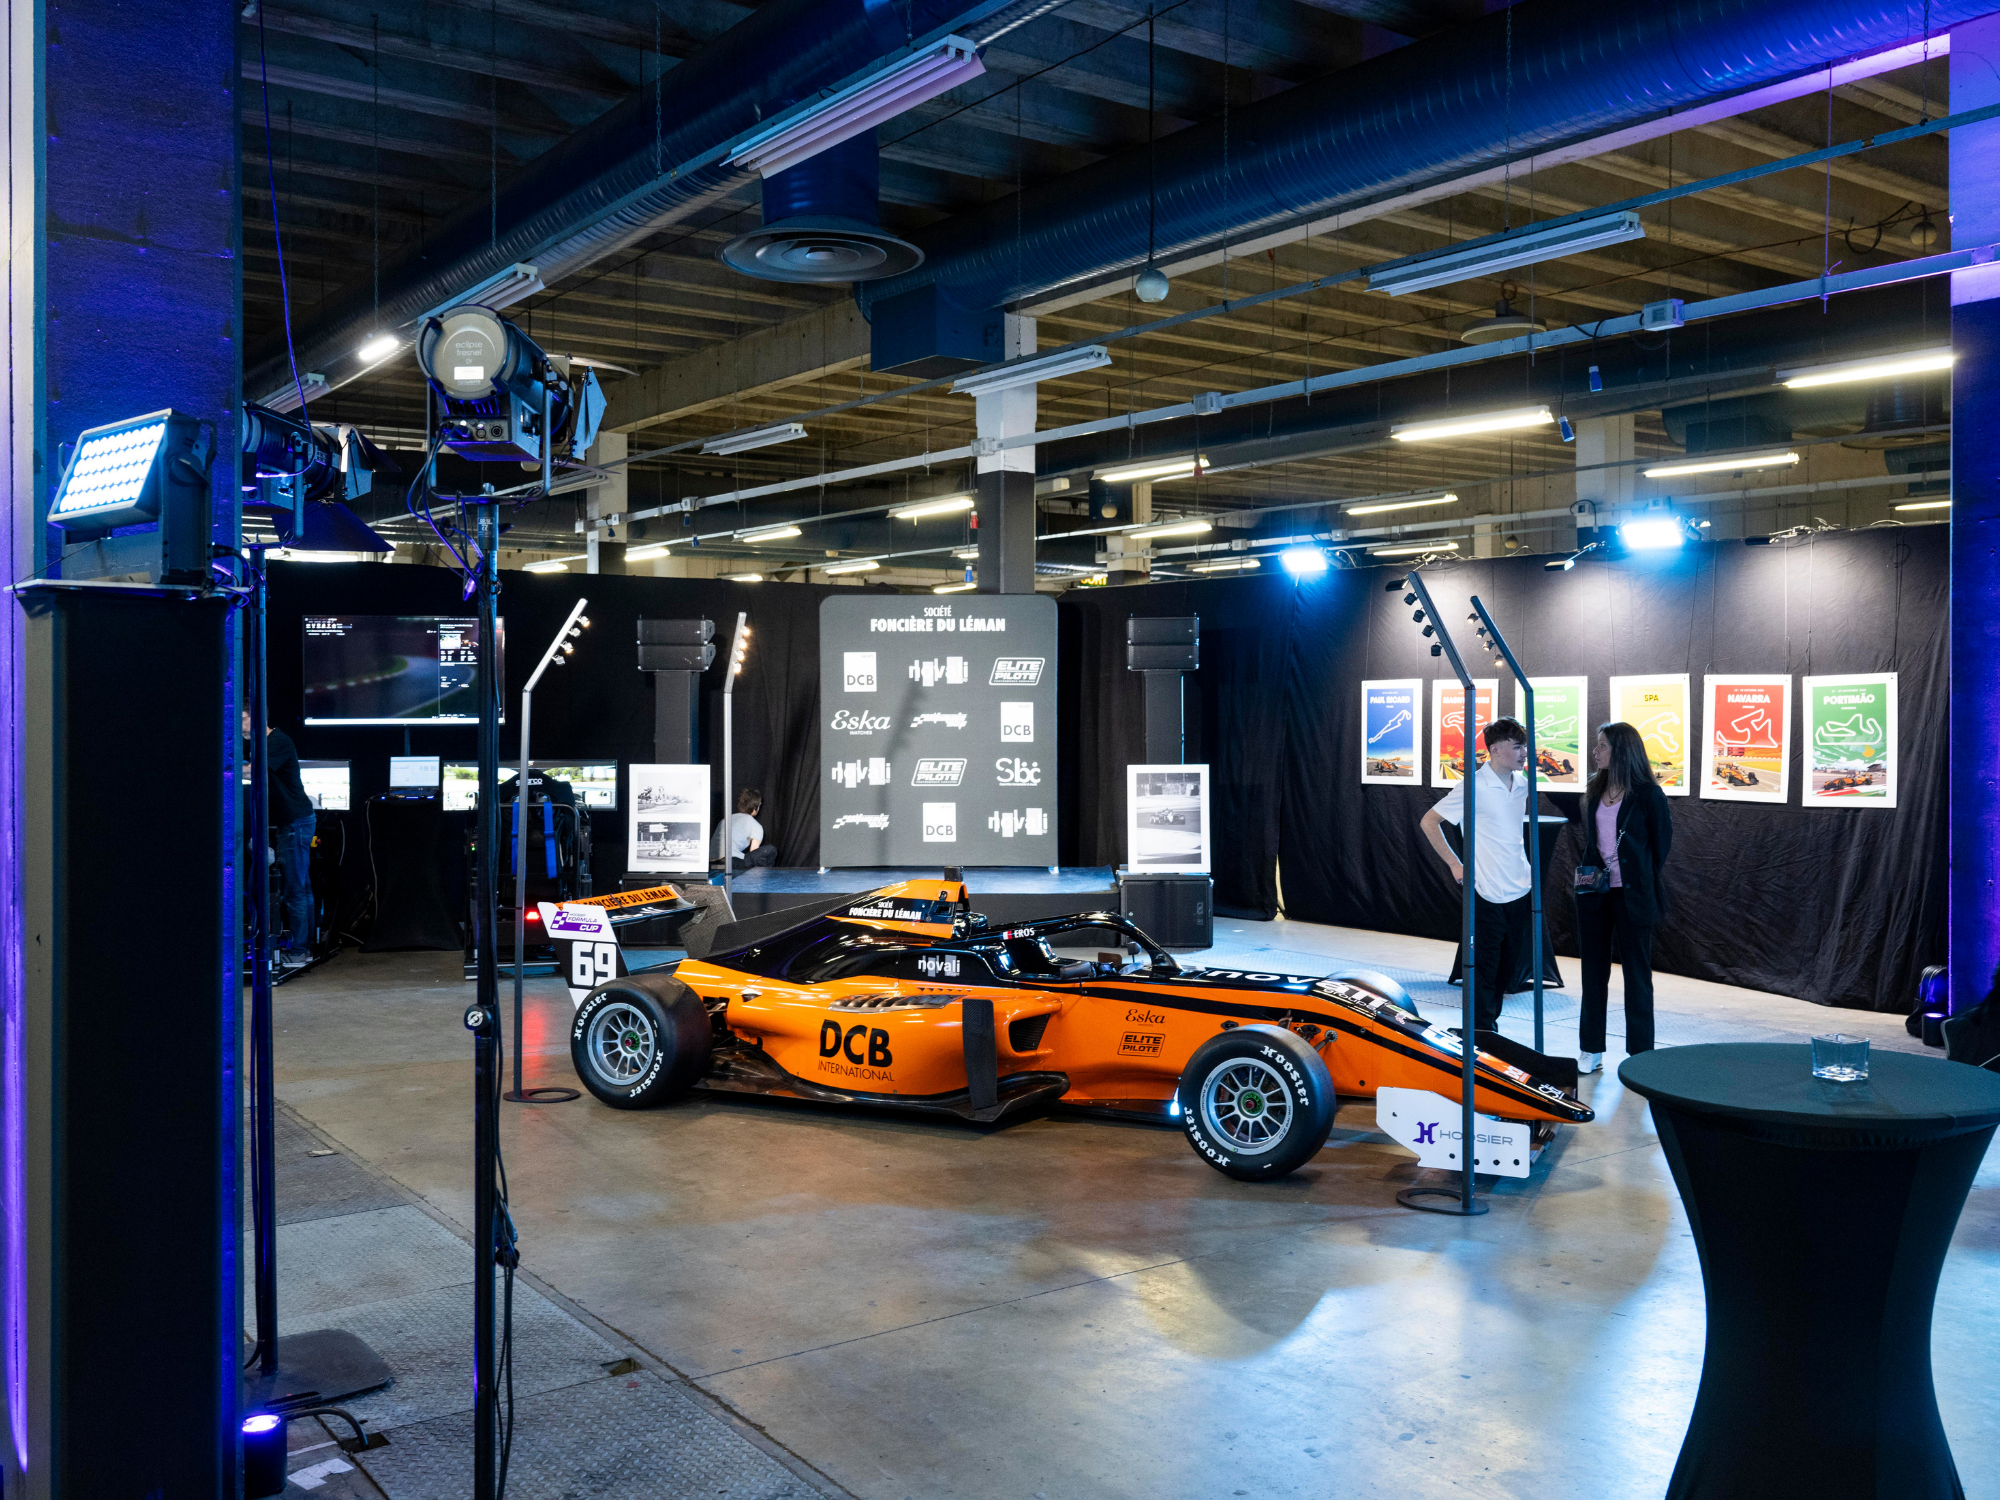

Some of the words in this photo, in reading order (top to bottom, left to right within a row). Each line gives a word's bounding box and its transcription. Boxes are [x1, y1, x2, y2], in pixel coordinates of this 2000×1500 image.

[455, 341, 483, 349] eclipse
[924, 605, 952, 617] SOCIÉTÉ
[870, 615, 933, 632] FONCIÈRE
[937, 618, 956, 632] DU
[959, 615, 1006, 632] LÉMAN
[997, 661, 1041, 671] ELITE
[847, 674, 874, 686] DCB
[994, 672, 1038, 680] PILOTE
[1370, 696, 1386, 704] PAUL
[1386, 695, 1411, 704] RICARD
[1643, 694, 1660, 702] SPA
[1727, 694, 1771, 703] NAVARRA
[1823, 693, 1875, 705] PORTIMÃO
[831, 709, 891, 730] Eska
[1003, 724, 1031, 736] DCB
[919, 761, 964, 771] ELITE
[916, 773, 960, 781] PILOTE
[926, 824, 954, 836] DCB
[627, 893, 643, 904] DU
[641, 888, 673, 902] LÉMAN
[849, 905, 882, 918] FONCIÈRE
[882, 909, 894, 919] DU
[894, 907, 922, 920] LÉMAN
[579, 924, 600, 932] CUP
[1014, 927, 1035, 939] EROS
[572, 941, 617, 987] 69
[918, 959, 960, 973] novali
[574, 992, 607, 1040] Hoosier
[1125, 1008, 1166, 1024] Eska
[819, 1019, 893, 1068] DCB
[1124, 1034, 1163, 1045] ELITE
[1122, 1044, 1160, 1053] PILOTE
[629, 1049, 664, 1098] Hoosier
[817, 1059, 895, 1082] INTERNATIONAL
[1260, 1045, 1310, 1107] Hoosier
[1184, 1106, 1231, 1167] Hoosier
[1439, 1129, 1514, 1147] HOSIER
